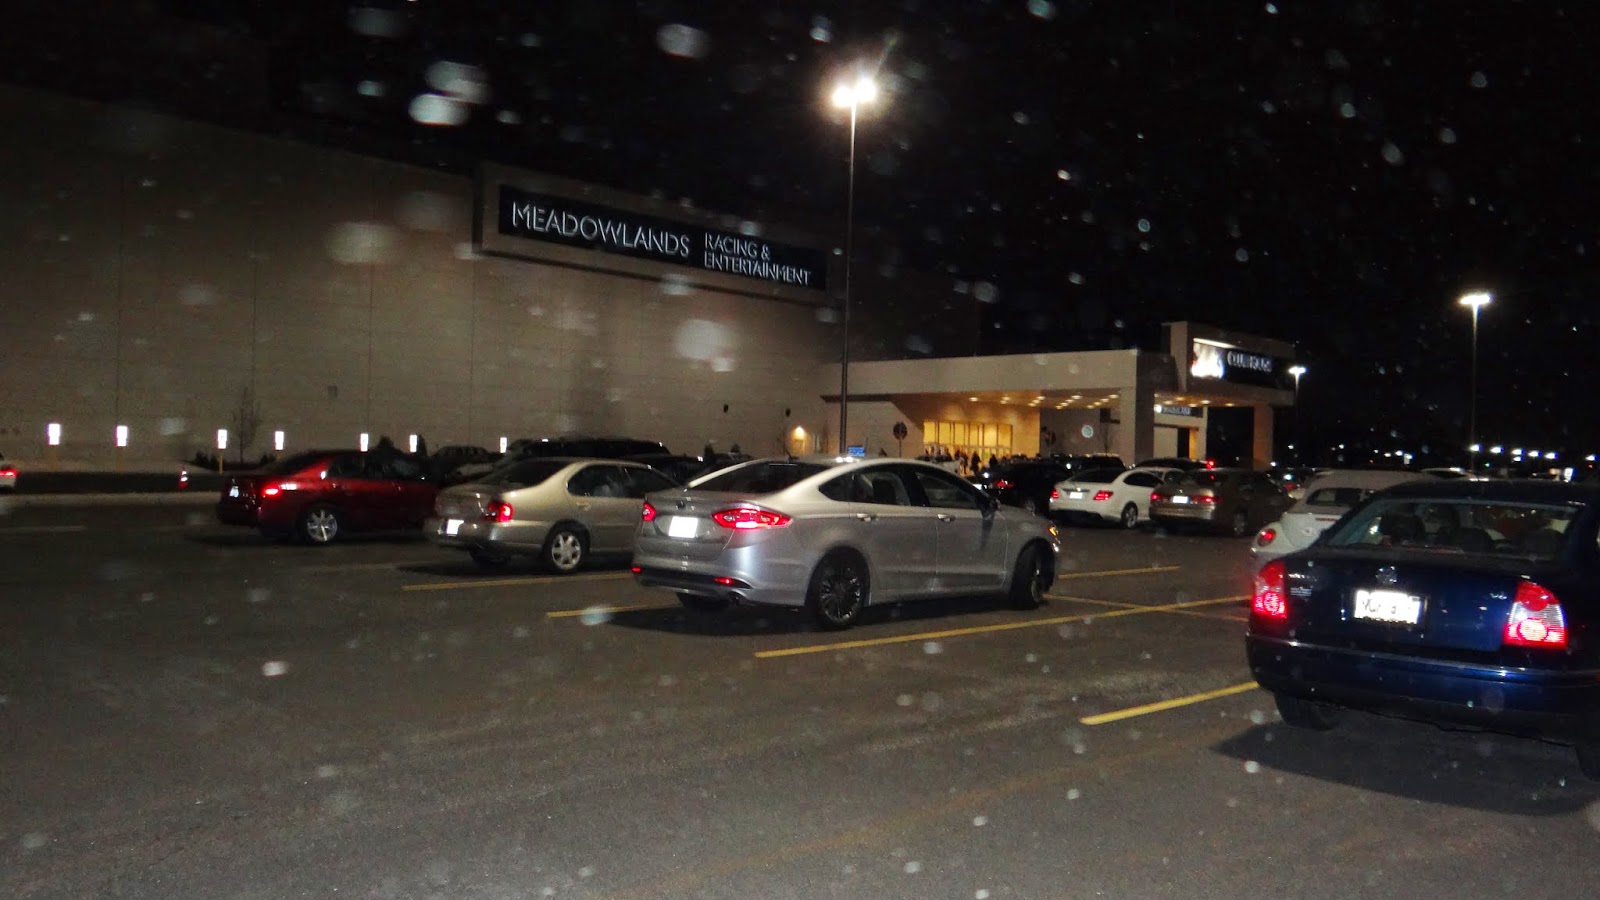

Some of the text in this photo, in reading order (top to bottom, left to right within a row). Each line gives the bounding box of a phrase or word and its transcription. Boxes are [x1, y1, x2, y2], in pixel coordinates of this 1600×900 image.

[511, 201, 689, 258] MEADOWLANDS
[704, 232, 771, 261] RACING &
[704, 251, 811, 286] ENTERTAINMENT
